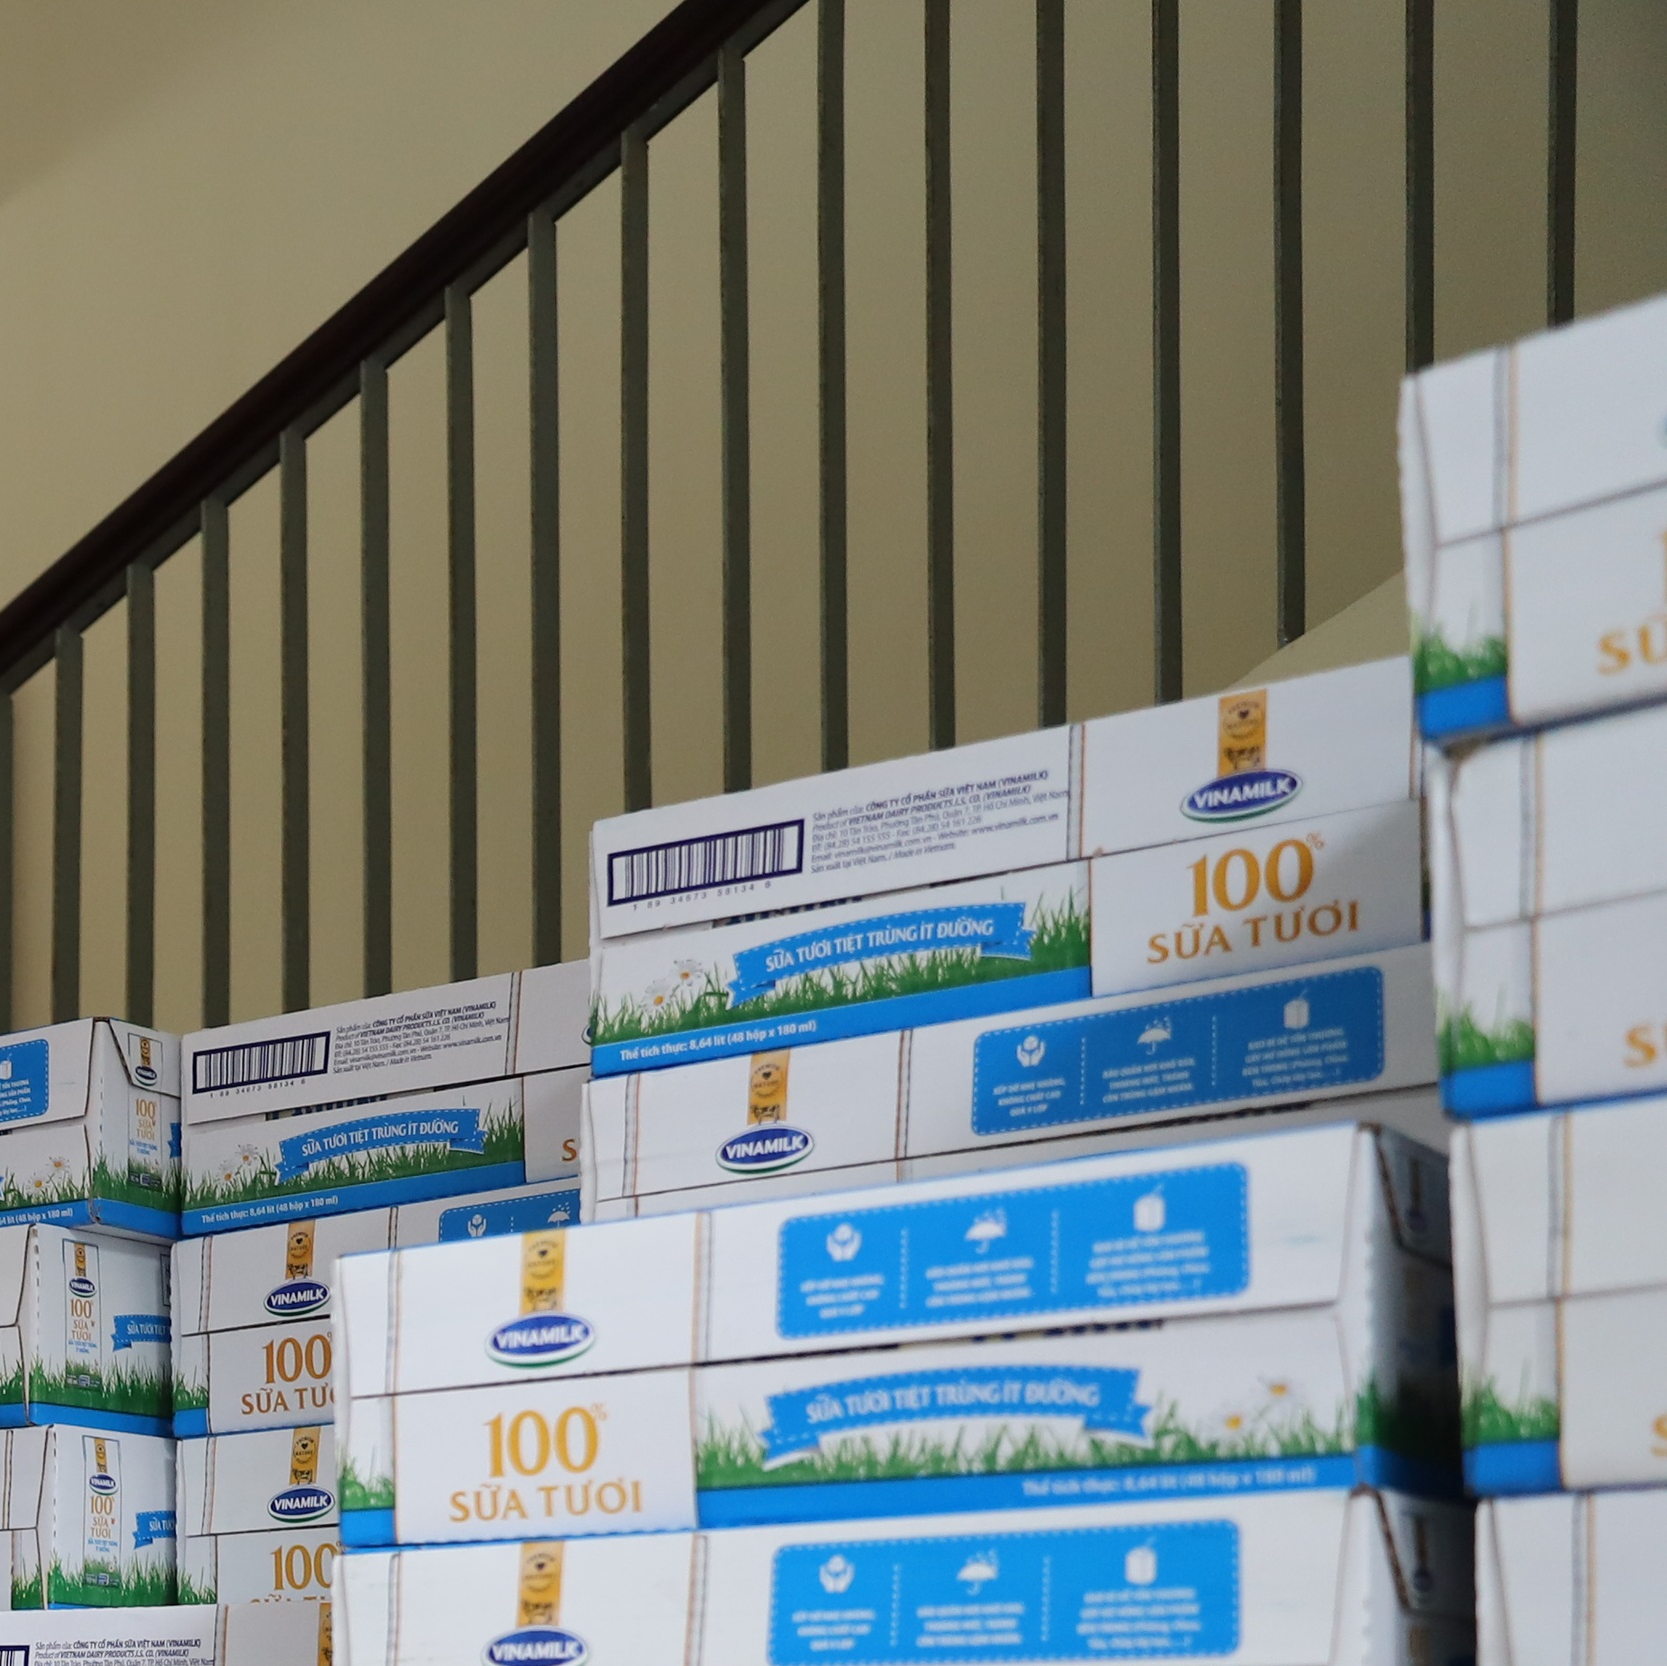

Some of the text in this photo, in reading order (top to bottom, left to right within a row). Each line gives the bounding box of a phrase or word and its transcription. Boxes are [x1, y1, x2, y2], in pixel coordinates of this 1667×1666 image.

[1195, 774, 1292, 809] VINAMILK
[723, 1132, 806, 1166] VINAMILK
[494, 1321, 585, 1352] VINAMILK
